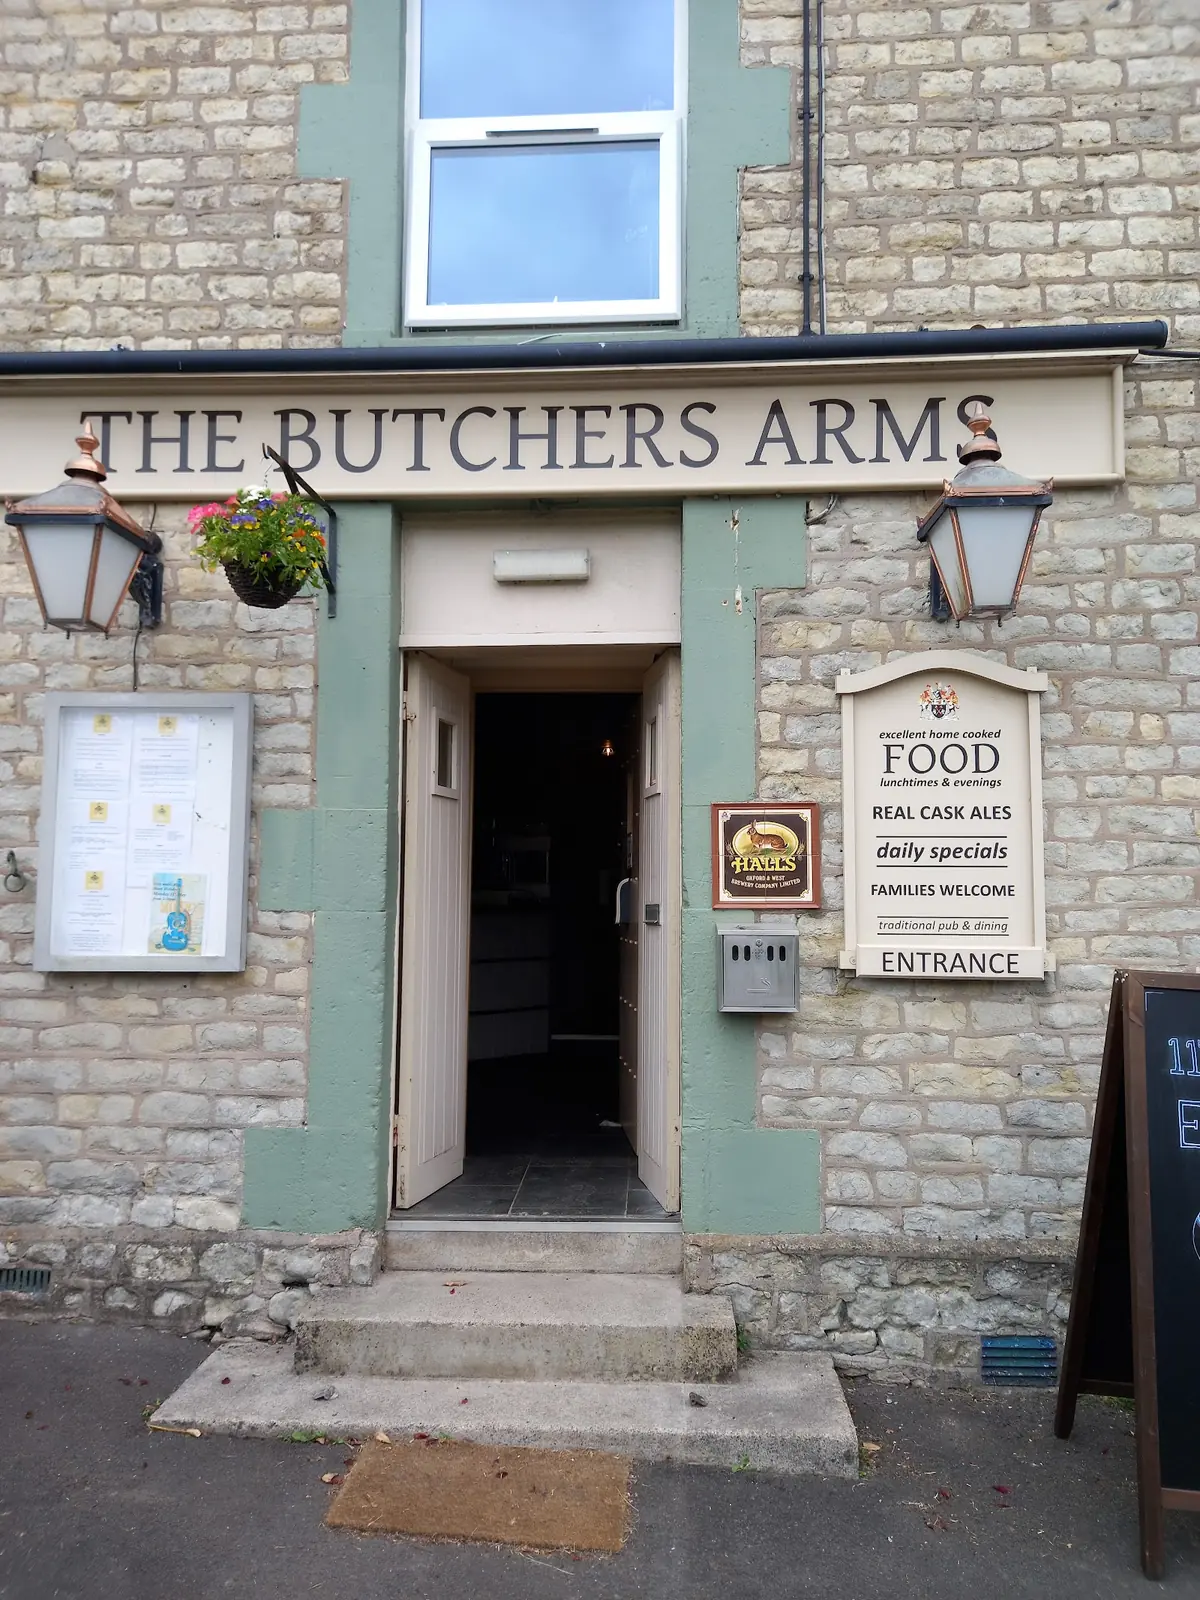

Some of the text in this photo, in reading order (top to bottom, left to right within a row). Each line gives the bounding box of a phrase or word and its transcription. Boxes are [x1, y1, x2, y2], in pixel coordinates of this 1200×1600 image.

[80, 395, 997, 473] THE BUTCHERS ARMS
[879, 729, 1002, 739] excellent home cooked
[882, 743, 1000, 774] FOOD
[880, 777, 1002, 789] lunchtimes & evenings
[872, 805, 1012, 820] REAL CASK ALES
[876, 841, 1008, 863] daily specials
[731, 857, 796, 874] HALLS
[871, 884, 1015, 897] FAMILIES WELCOME
[878, 920, 1008, 933] traditional pub & dining
[882, 952, 1020, 974] ENTRANCE
